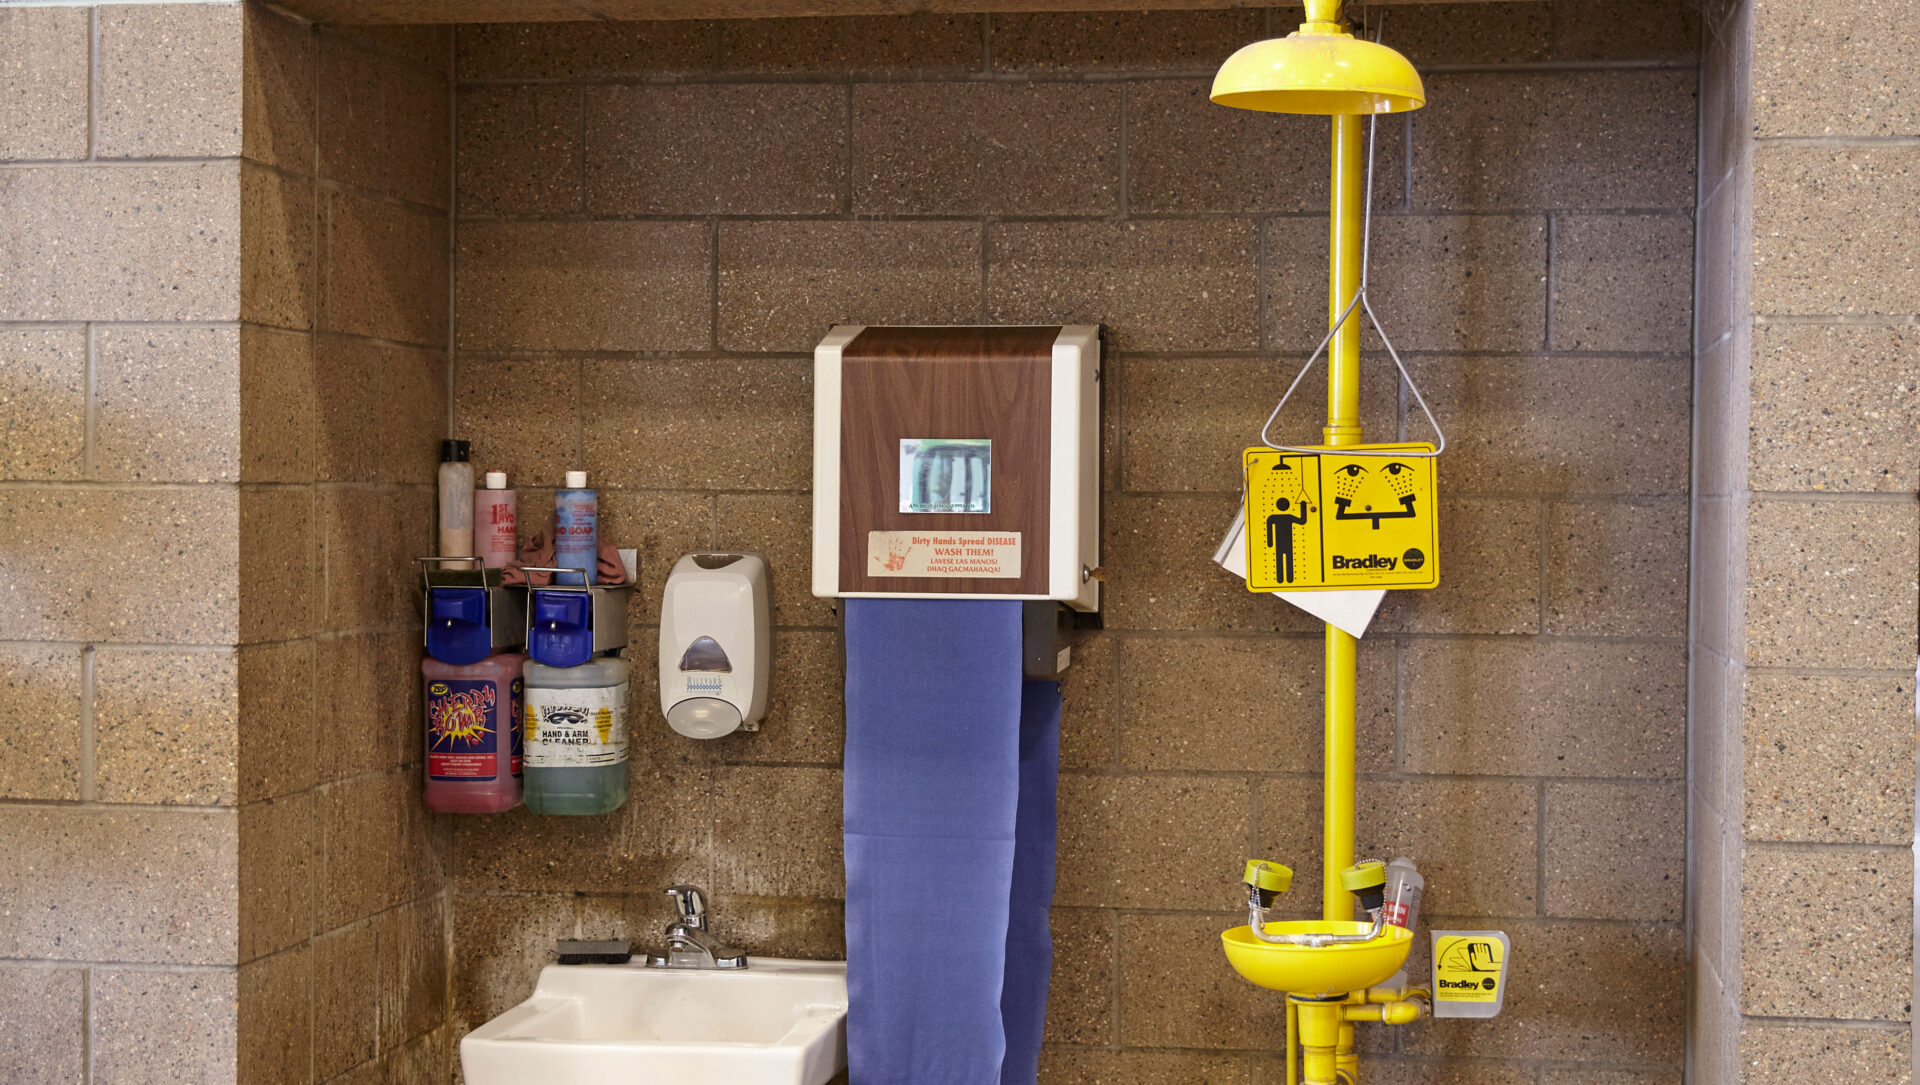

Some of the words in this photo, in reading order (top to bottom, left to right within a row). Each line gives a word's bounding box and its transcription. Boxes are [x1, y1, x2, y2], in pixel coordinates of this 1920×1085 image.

[569, 526, 593, 535] SOAP
[912, 537, 930, 547] Dirty
[933, 537, 956, 545] Hands
[959, 537, 985, 547] Spread
[987, 537, 1016, 546] DISEASE
[935, 548, 962, 556] WASH
[966, 548, 994, 556] THEM!
[1332, 554, 1398, 571] Bradley
[429, 685, 496, 719] CHERRY
[433, 706, 486, 738] BOMB
[542, 730, 562, 738] HAND
[565, 730, 570, 738] &
[572, 730, 589, 738] ARM
[542, 738, 589, 746] CLEANER
[1439, 979, 1479, 990] Bradley
